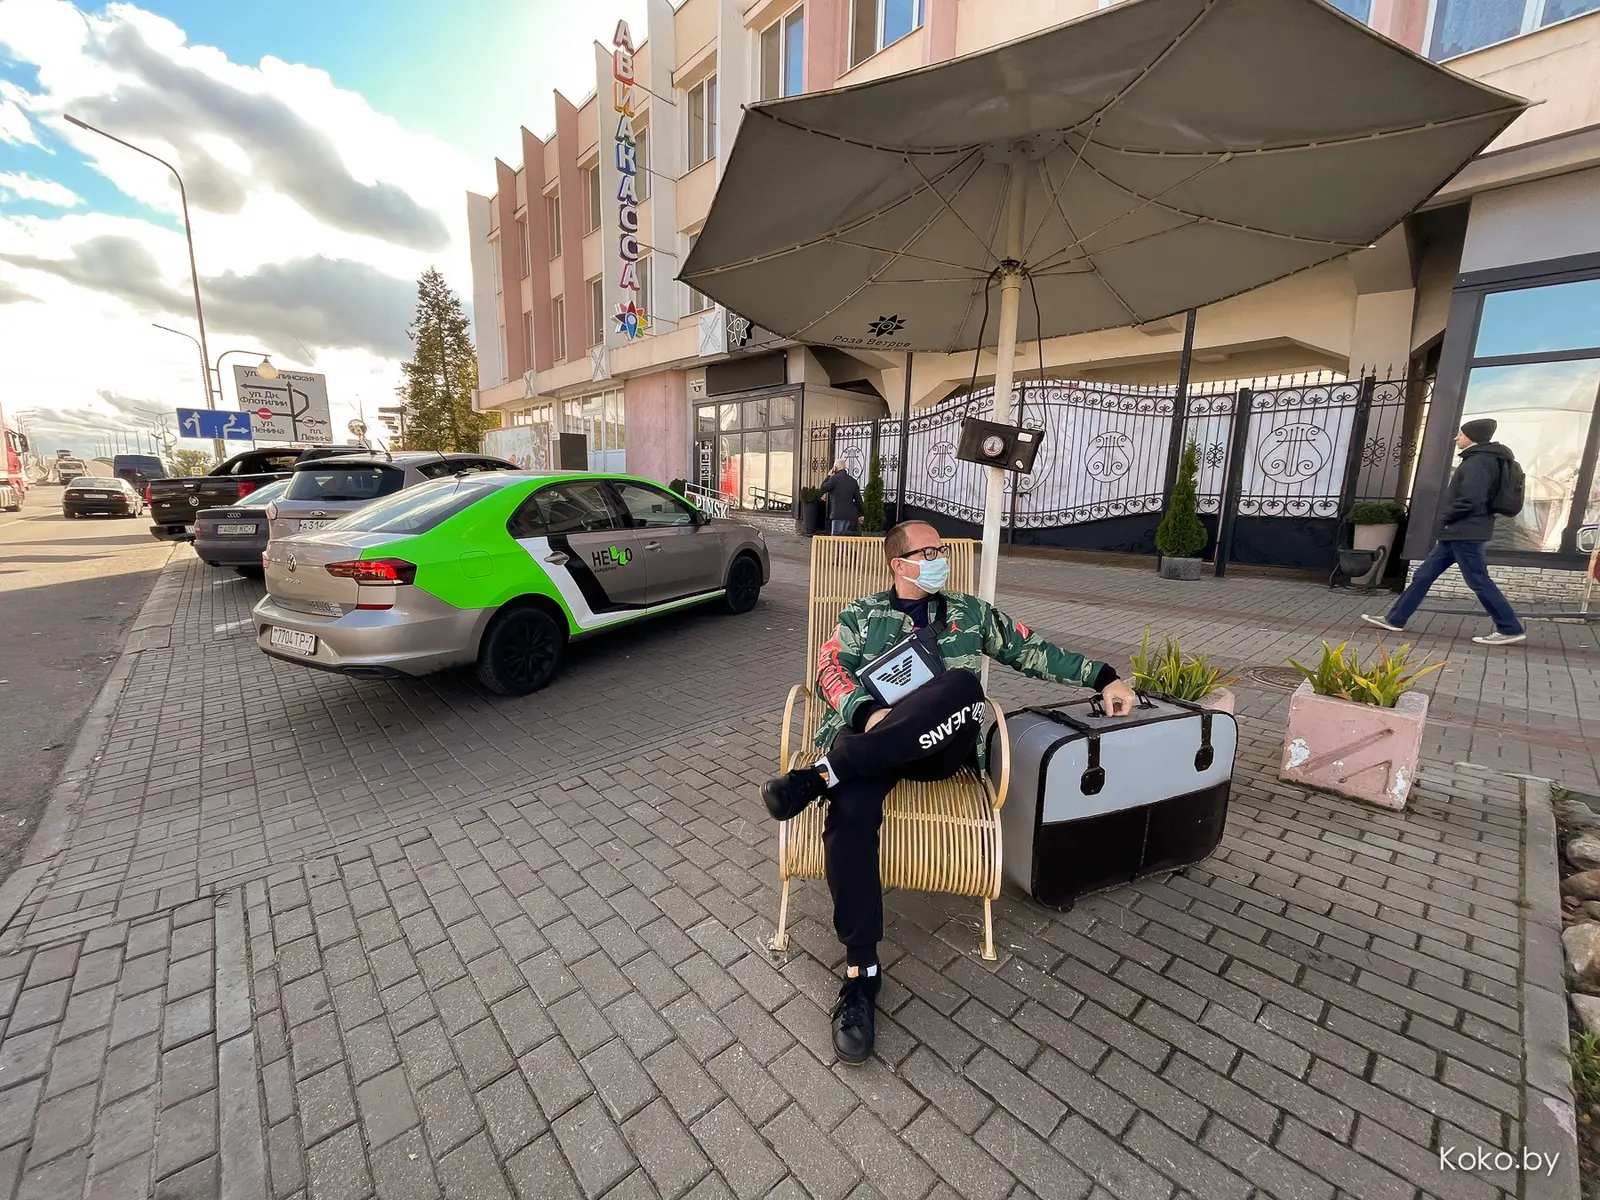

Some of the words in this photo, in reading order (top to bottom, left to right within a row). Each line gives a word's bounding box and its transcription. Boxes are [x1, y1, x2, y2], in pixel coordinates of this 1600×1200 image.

[613, 18, 641, 292] АВИАКАССА
[832, 335, 863, 344] Роза
[866, 338, 912, 348] Ветров
[240, 396, 288, 407] Флотилии
[252, 426, 285, 435] Ленина
[261, 420, 275, 428] ул.
[301, 434, 332, 442] Ленина
[695, 494, 729, 519] PINSK
[591, 545, 633, 566] HELLO
[277, 628, 293, 644] 7704
[918, 706, 971, 750] JEANS
